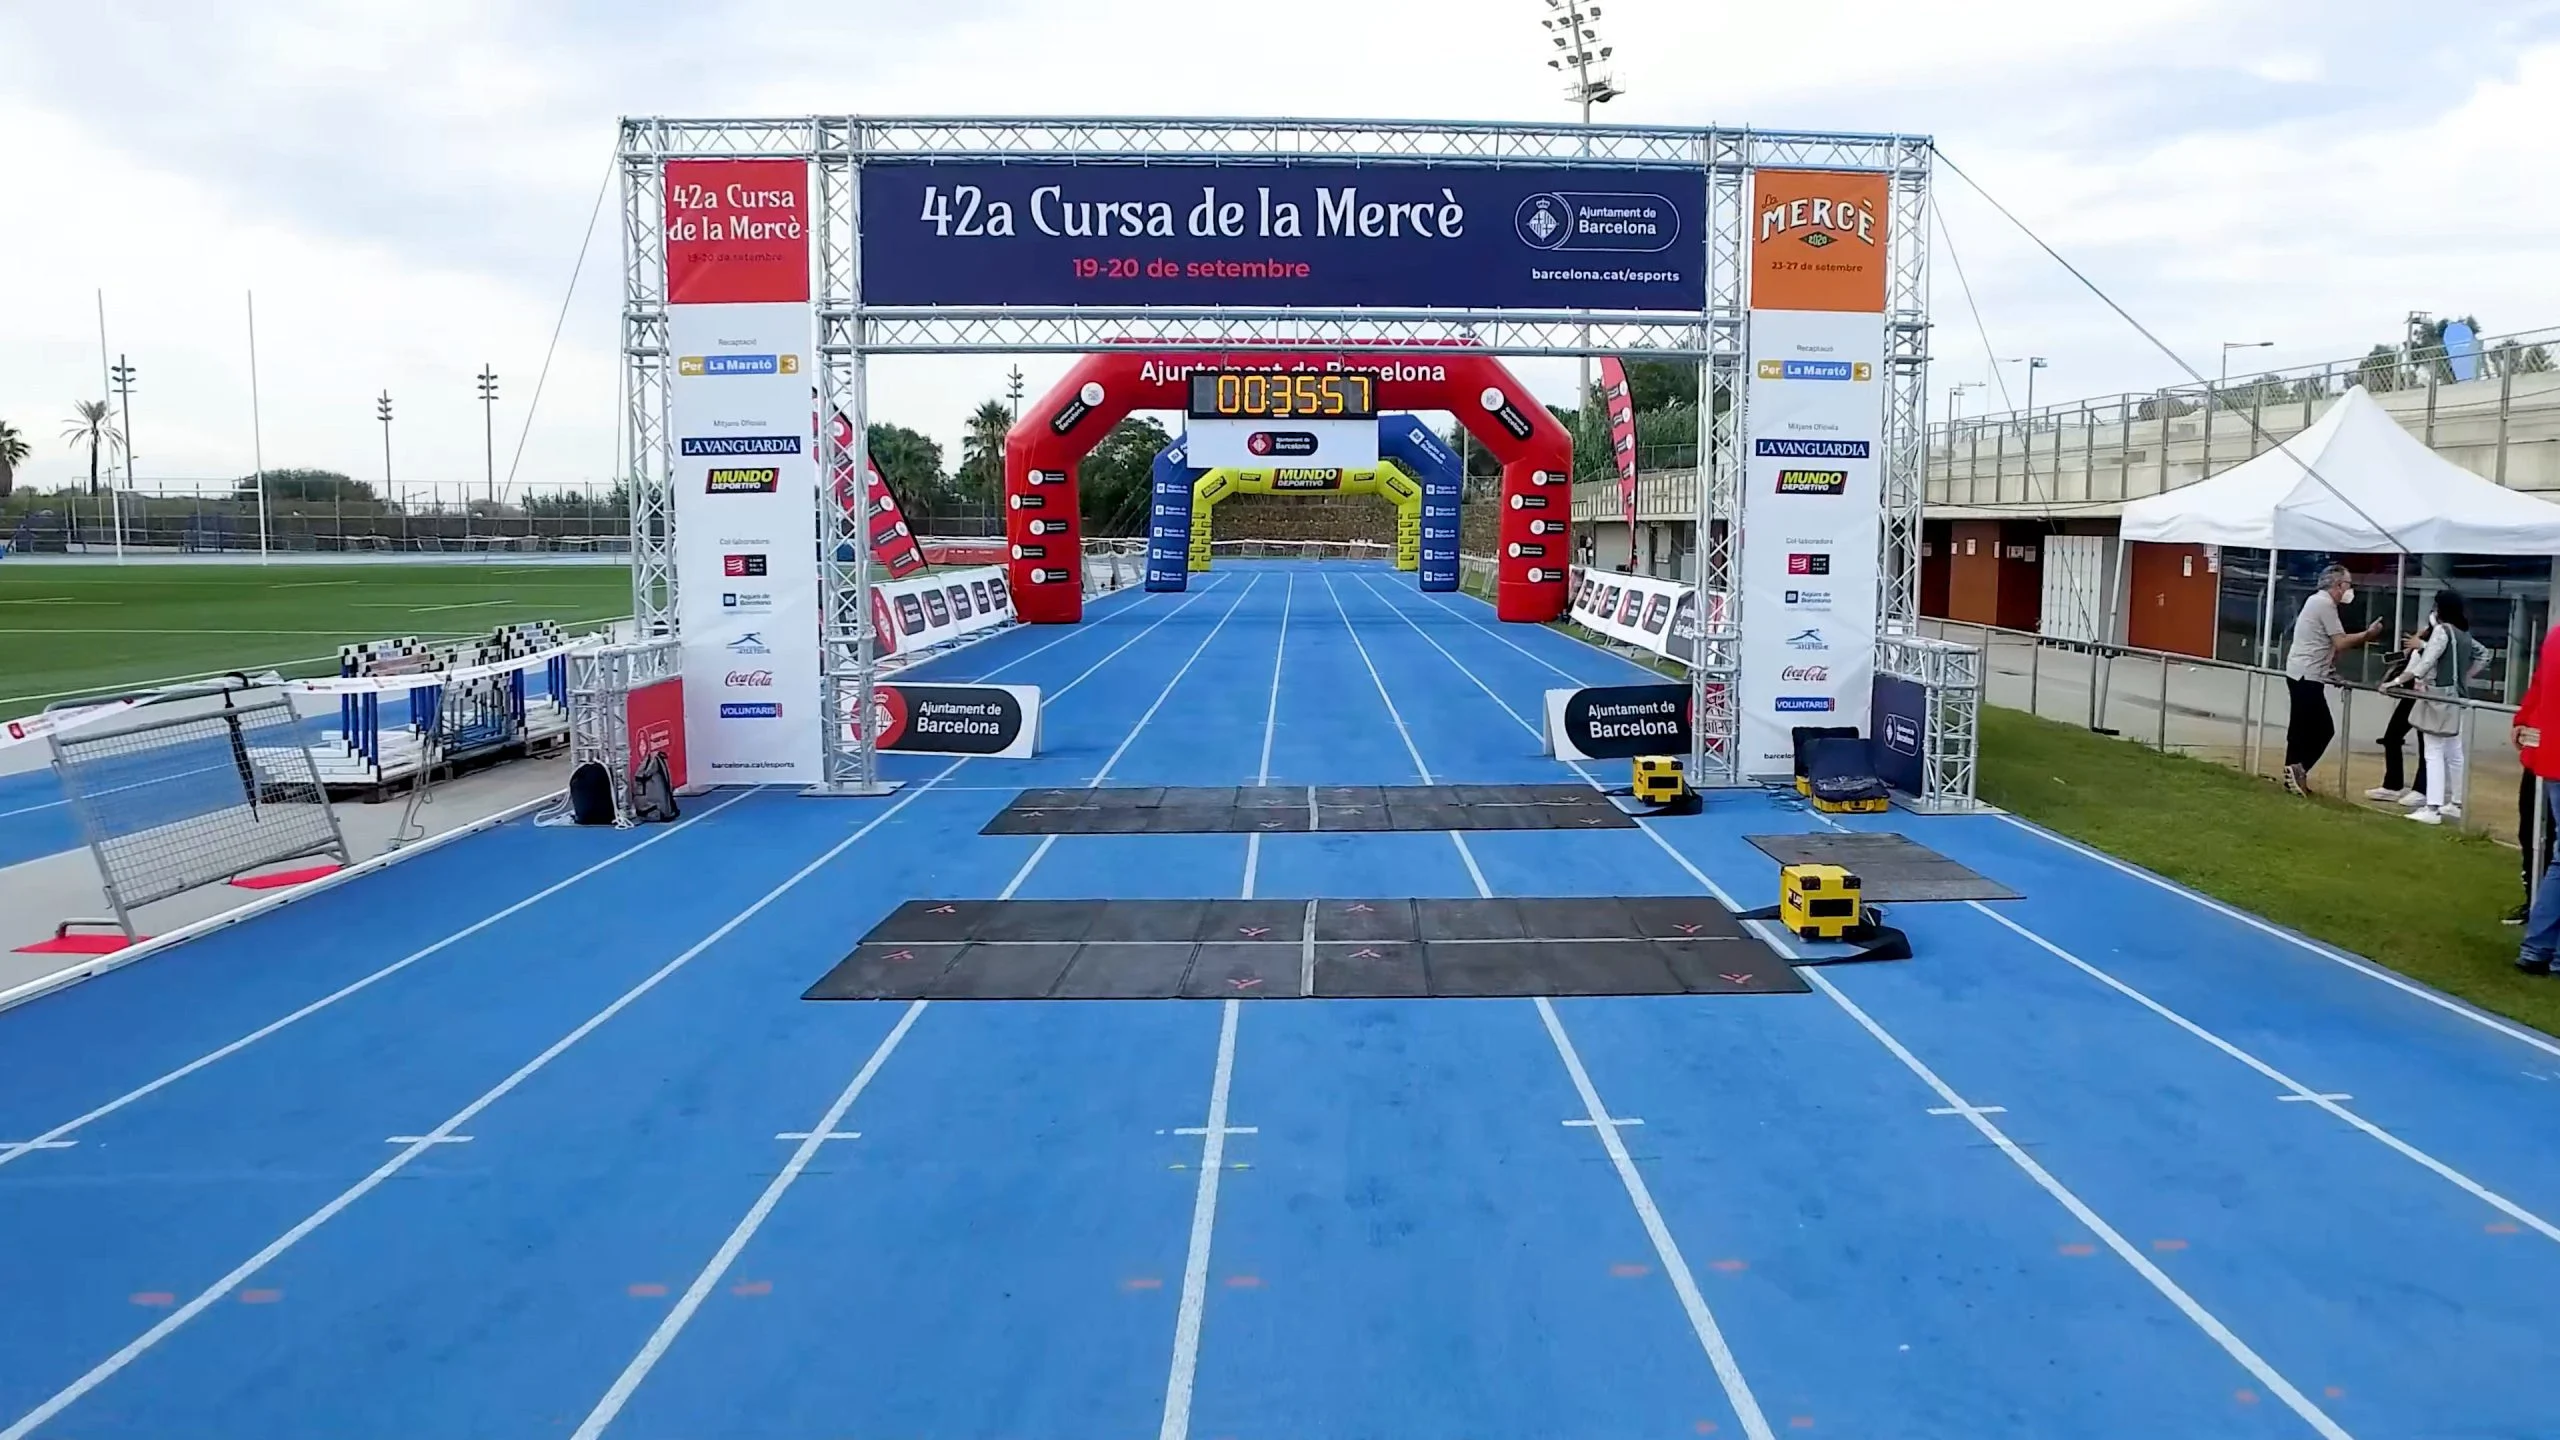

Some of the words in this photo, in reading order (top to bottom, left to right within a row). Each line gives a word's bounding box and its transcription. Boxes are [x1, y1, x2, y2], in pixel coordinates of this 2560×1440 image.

[673, 184, 718, 209] 42a
[726, 183, 795, 208] Cursa
[921, 184, 1015, 238] 42a
[1030, 184, 1174, 238] Cursa
[1187, 187, 1244, 238] de
[1258, 187, 1302, 238] la
[1315, 187, 1464, 239] Mercè
[1579, 206, 1641, 220] Ajuntament
[1643, 206, 1657, 218] de
[669, 217, 697, 241] de
[702, 216, 724, 241] la
[729, 215, 801, 240] Mercè
[1579, 220, 1657, 235] Barcelona
[1761, 197, 1876, 247] MERCÈ
[1073, 259, 1139, 278] 19-20
[1146, 258, 1180, 278] de
[1186, 258, 1311, 279] setembre
[1771, 262, 1798, 270] 23-27
[1800, 262, 1813, 271] de
[1815, 262, 1863, 272] setembre
[1532, 268, 1680, 283] barcelona.cat/esports
[681, 361, 703, 371] Per
[709, 360, 725, 371] La
[726, 359, 773, 371] Marató
[1760, 365, 1781, 375] Per
[1787, 365, 1801, 375] La
[1803, 365, 1847, 376] Marató
[1217, 375, 1370, 414] 00:35:57
[712, 470, 774, 483] MUNDO
[1278, 469, 1337, 481] MUNDO
[1783, 472, 1843, 485] MUNDO
[721, 707, 776, 715] VOLUNTARIS
[919, 701, 984, 716] Ajuntament
[987, 703, 1002, 715] de
[1588, 702, 1658, 719] Ajuntament
[1660, 700, 1675, 713] de
[1776, 701, 1829, 709] VOLUNTARIS
[917, 717, 1000, 735] Barcelona
[1589, 718, 1679, 738] Barcelona
